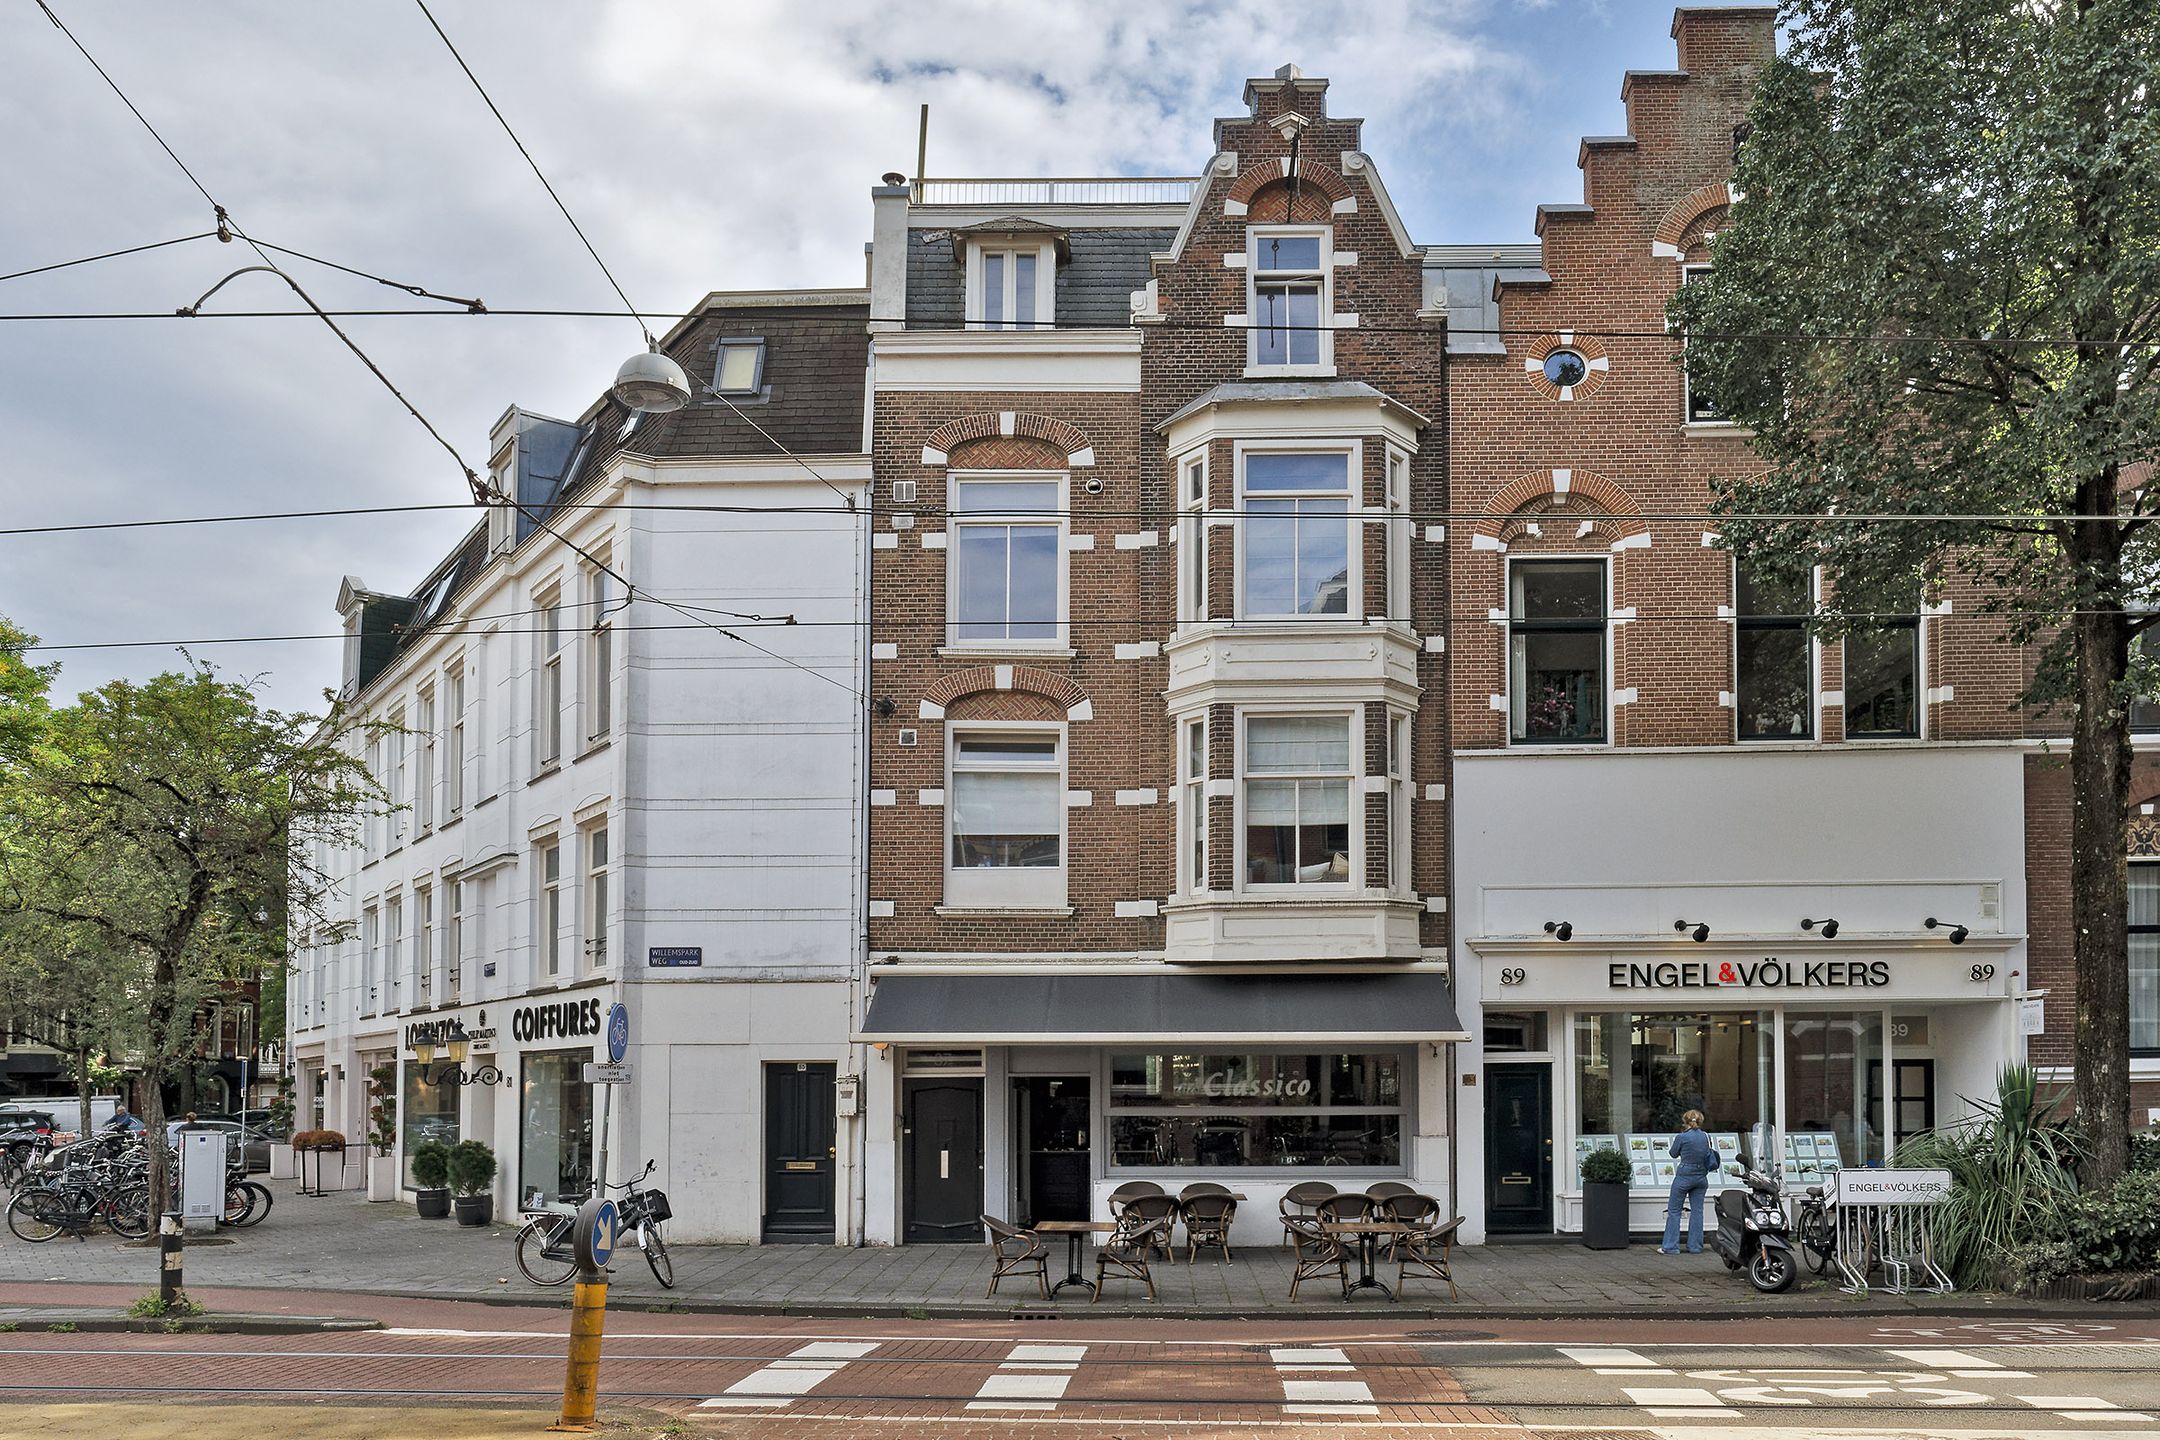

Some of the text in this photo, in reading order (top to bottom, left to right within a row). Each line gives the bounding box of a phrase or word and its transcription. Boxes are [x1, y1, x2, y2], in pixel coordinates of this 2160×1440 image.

[651, 957, 667, 965] WEG
[1608, 957, 1889, 988] ENGEL&VÖLKERS
[1970, 964, 1995, 981] 89
[1500, 967, 1525, 985] 89
[513, 997, 600, 1042] COIFFURES
[405, 1018, 455, 1051] LONZO
[1204, 1068, 1311, 1097] Classico
[1849, 1182, 1941, 1192] ENGEL&VÖLKERS
